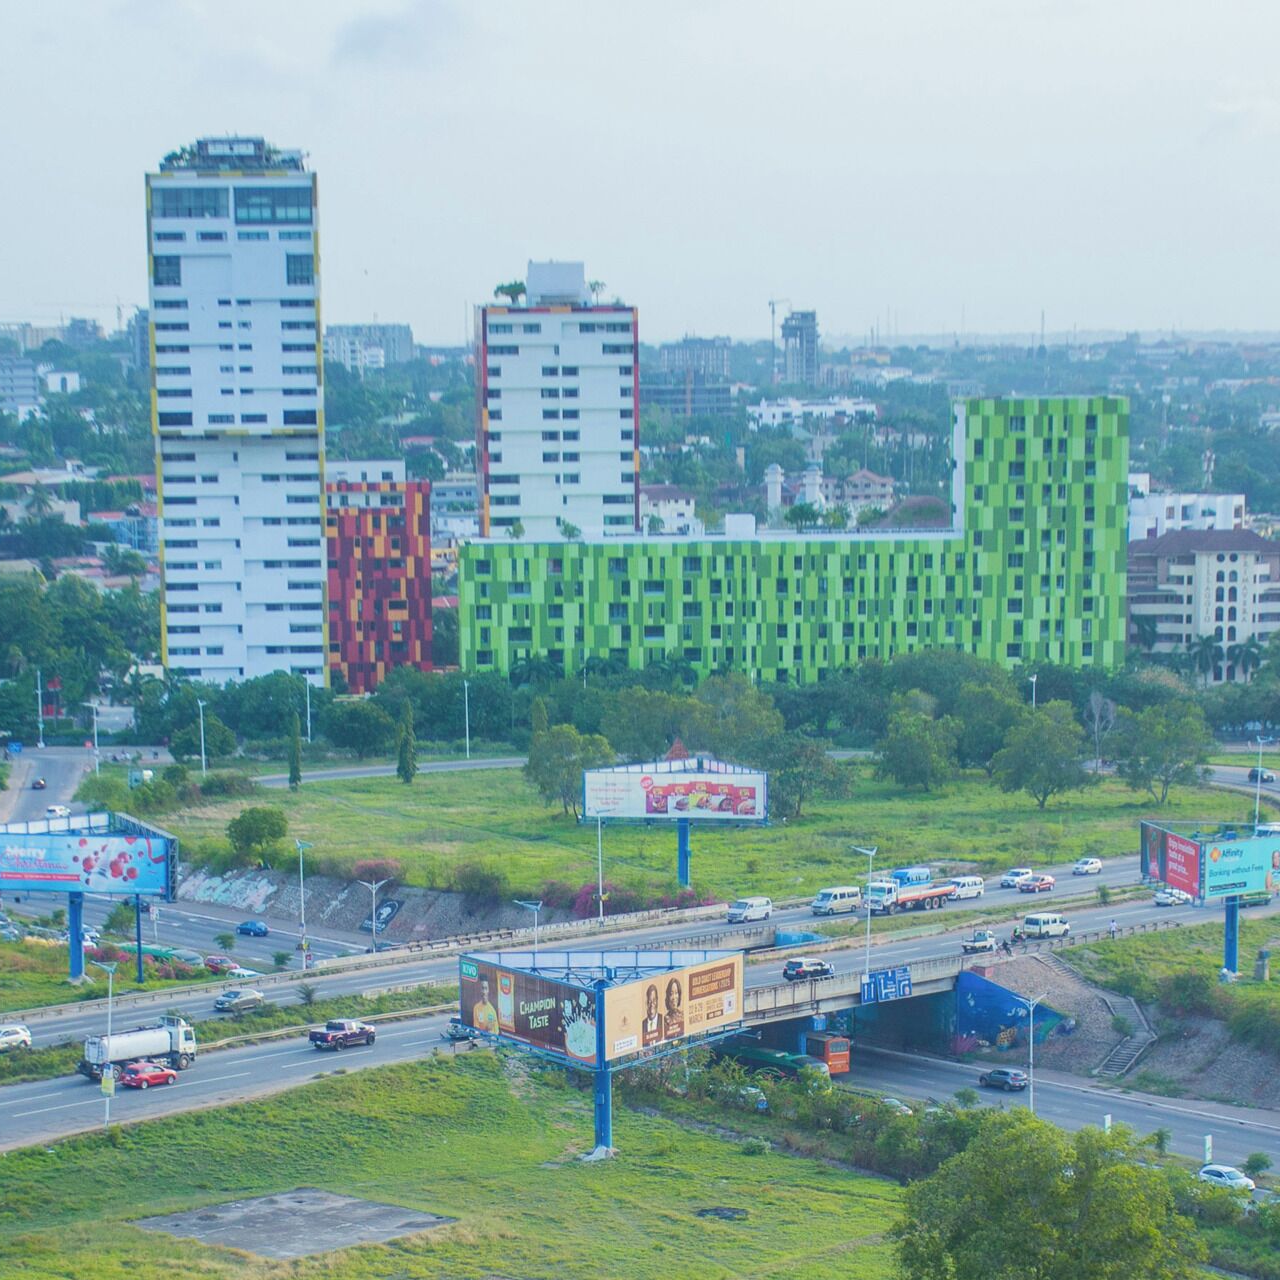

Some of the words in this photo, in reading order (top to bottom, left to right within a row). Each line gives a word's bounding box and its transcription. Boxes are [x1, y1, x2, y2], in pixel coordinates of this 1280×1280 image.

[1222, 848, 1244, 858] Affinity
[1209, 869, 1230, 878] Banking
[462, 963, 478, 977] KIVO
[520, 997, 556, 1015] CHAMPION
[528, 1015, 550, 1029] TASTE
